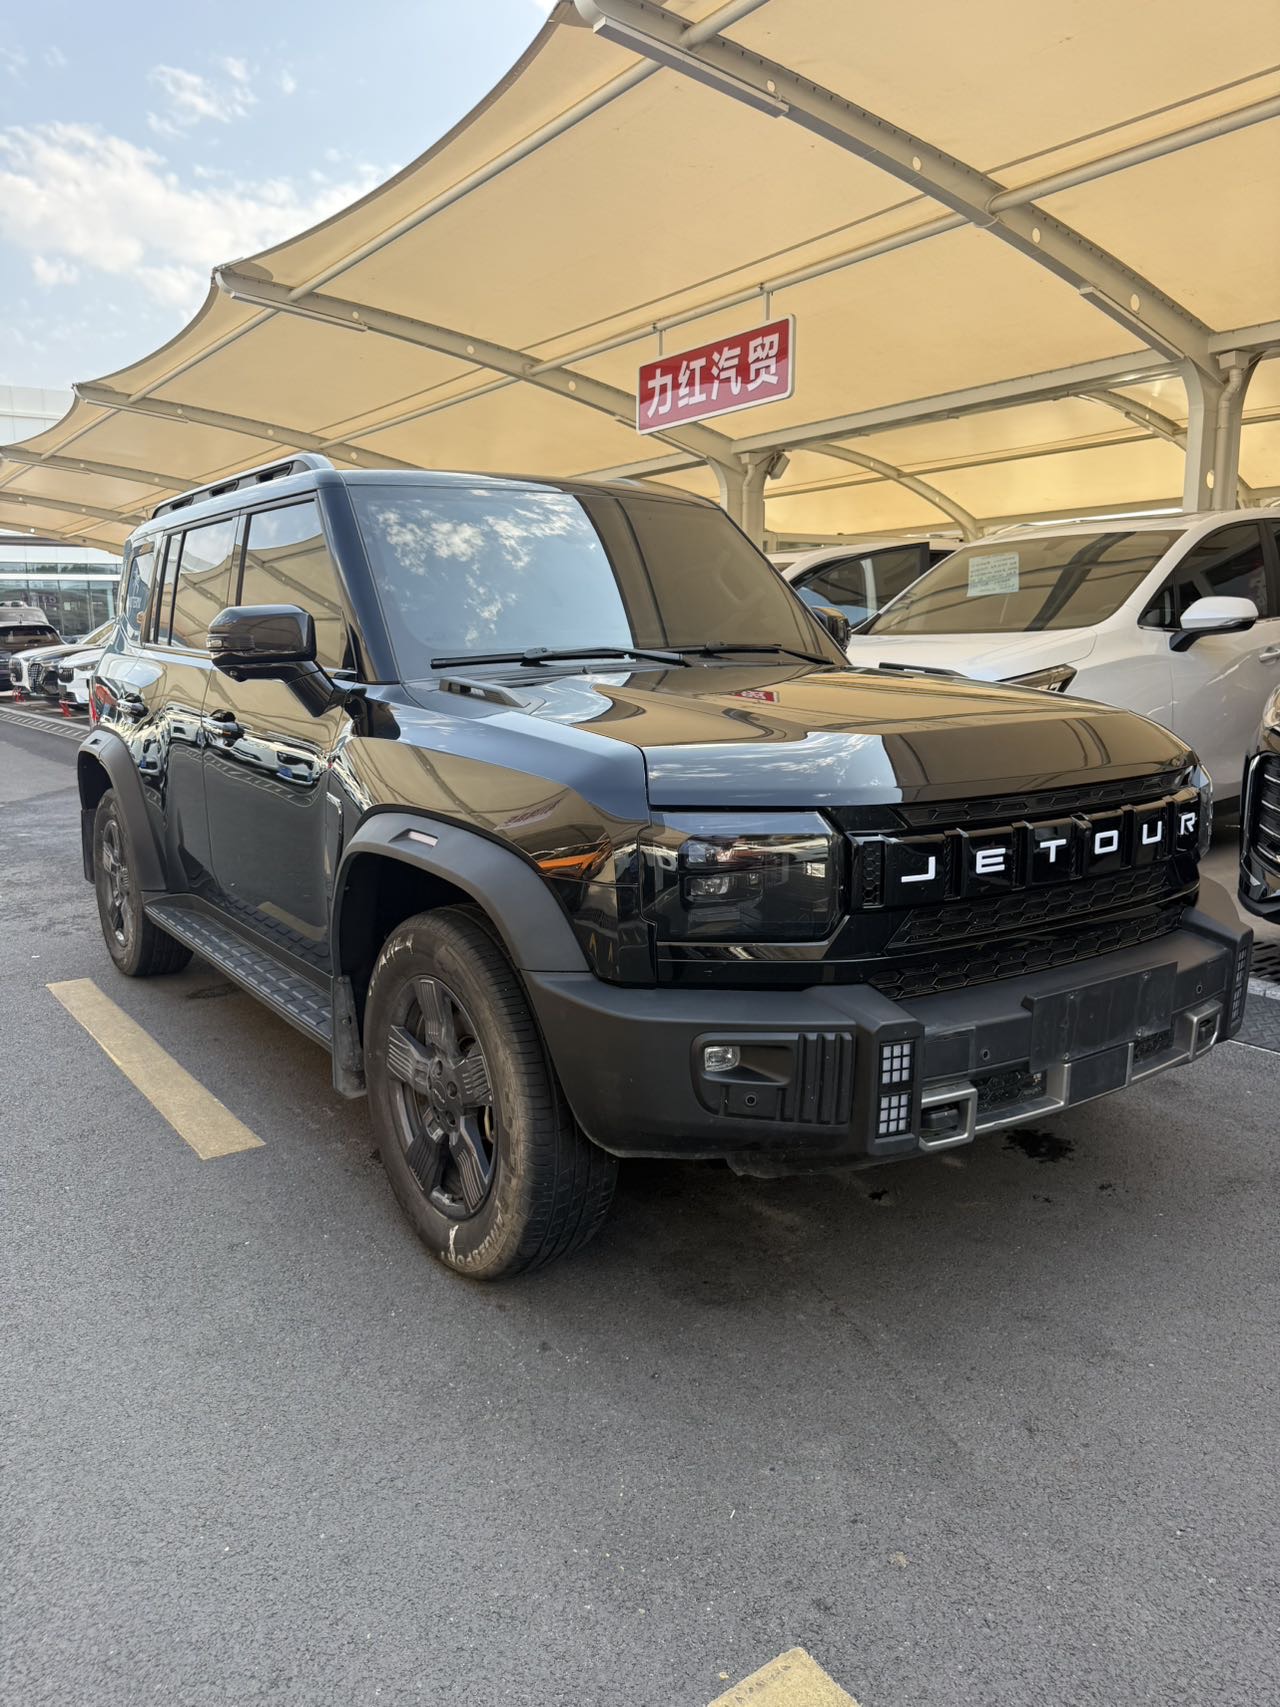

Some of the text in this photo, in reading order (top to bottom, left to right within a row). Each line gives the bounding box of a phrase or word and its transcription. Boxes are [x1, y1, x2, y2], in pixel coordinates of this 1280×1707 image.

[647, 333, 780, 418] 力红汽贸
[901, 812, 1197, 883] JETOUR
